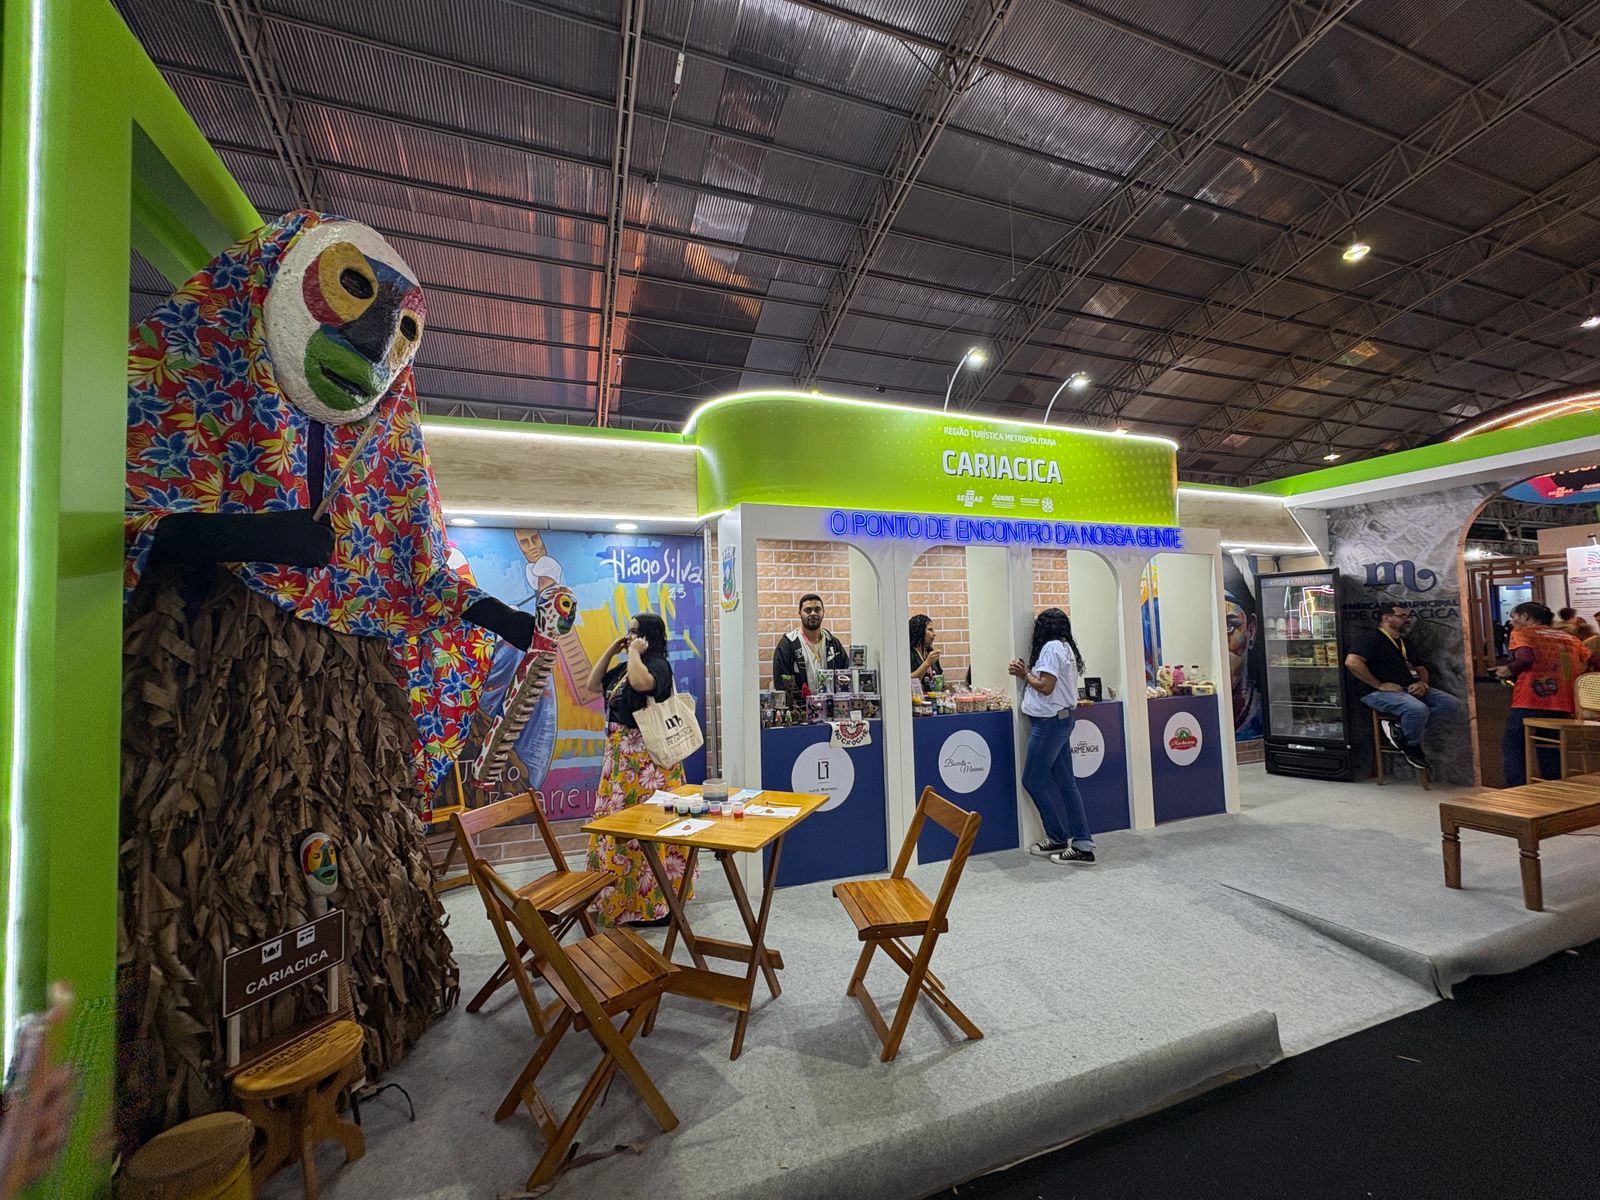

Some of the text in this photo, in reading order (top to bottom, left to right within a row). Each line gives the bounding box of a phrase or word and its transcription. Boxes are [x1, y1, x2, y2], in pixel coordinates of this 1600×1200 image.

[944, 426, 1057, 446] REGIÃO TURÍSTICA METROPOLITANA
[942, 450, 1063, 484] CARIACICA
[831, 511, 1184, 549] O PONTO DE ENCONTRO DA NOSSA GENTE
[657, 548, 703, 585] Silva
[1373, 607, 1459, 620] CACICA
[1402, 600, 1459, 609] MUNICIPAL
[245, 949, 329, 995] CARIACICA
